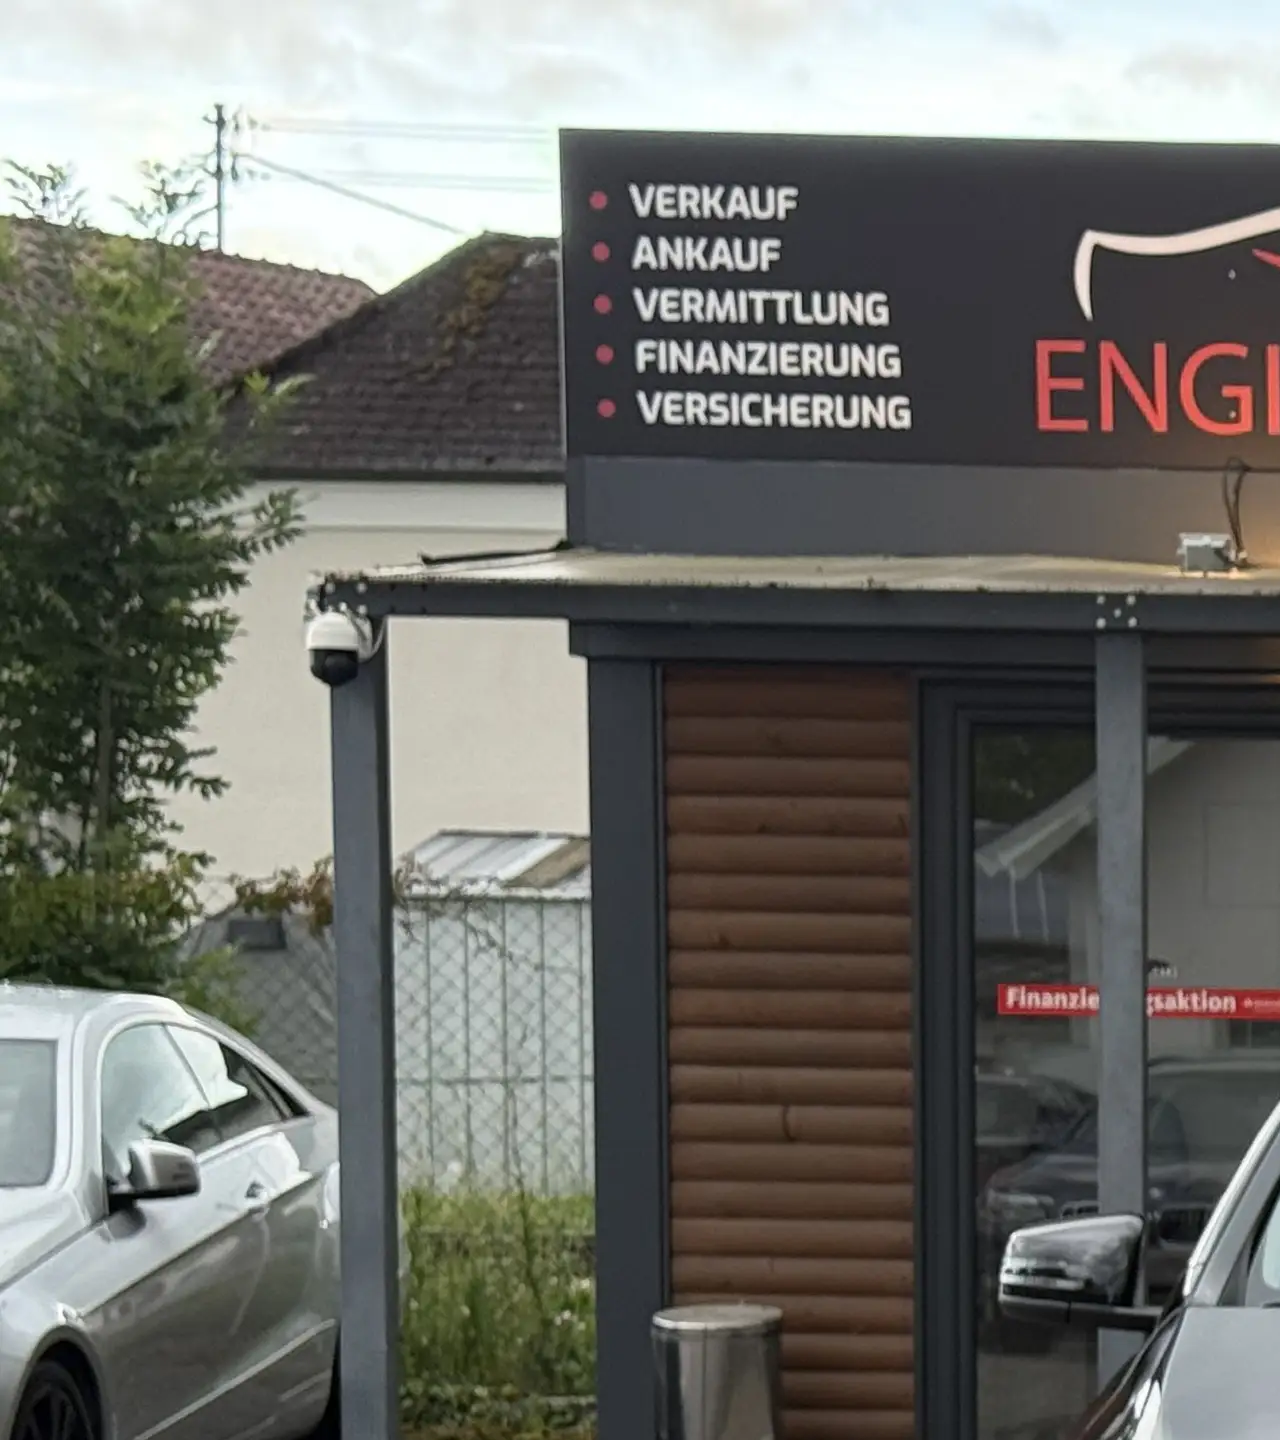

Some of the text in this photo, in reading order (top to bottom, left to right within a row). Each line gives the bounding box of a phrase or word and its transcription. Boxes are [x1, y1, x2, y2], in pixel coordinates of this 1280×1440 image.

[629, 184, 798, 221] VERKAUF
[631, 236, 782, 272] ANKAUF
[632, 287, 889, 327] VERMITTLUNG
[635, 339, 901, 379] FINANZIERUNG
[637, 391, 912, 429] VERSICHERUNG
